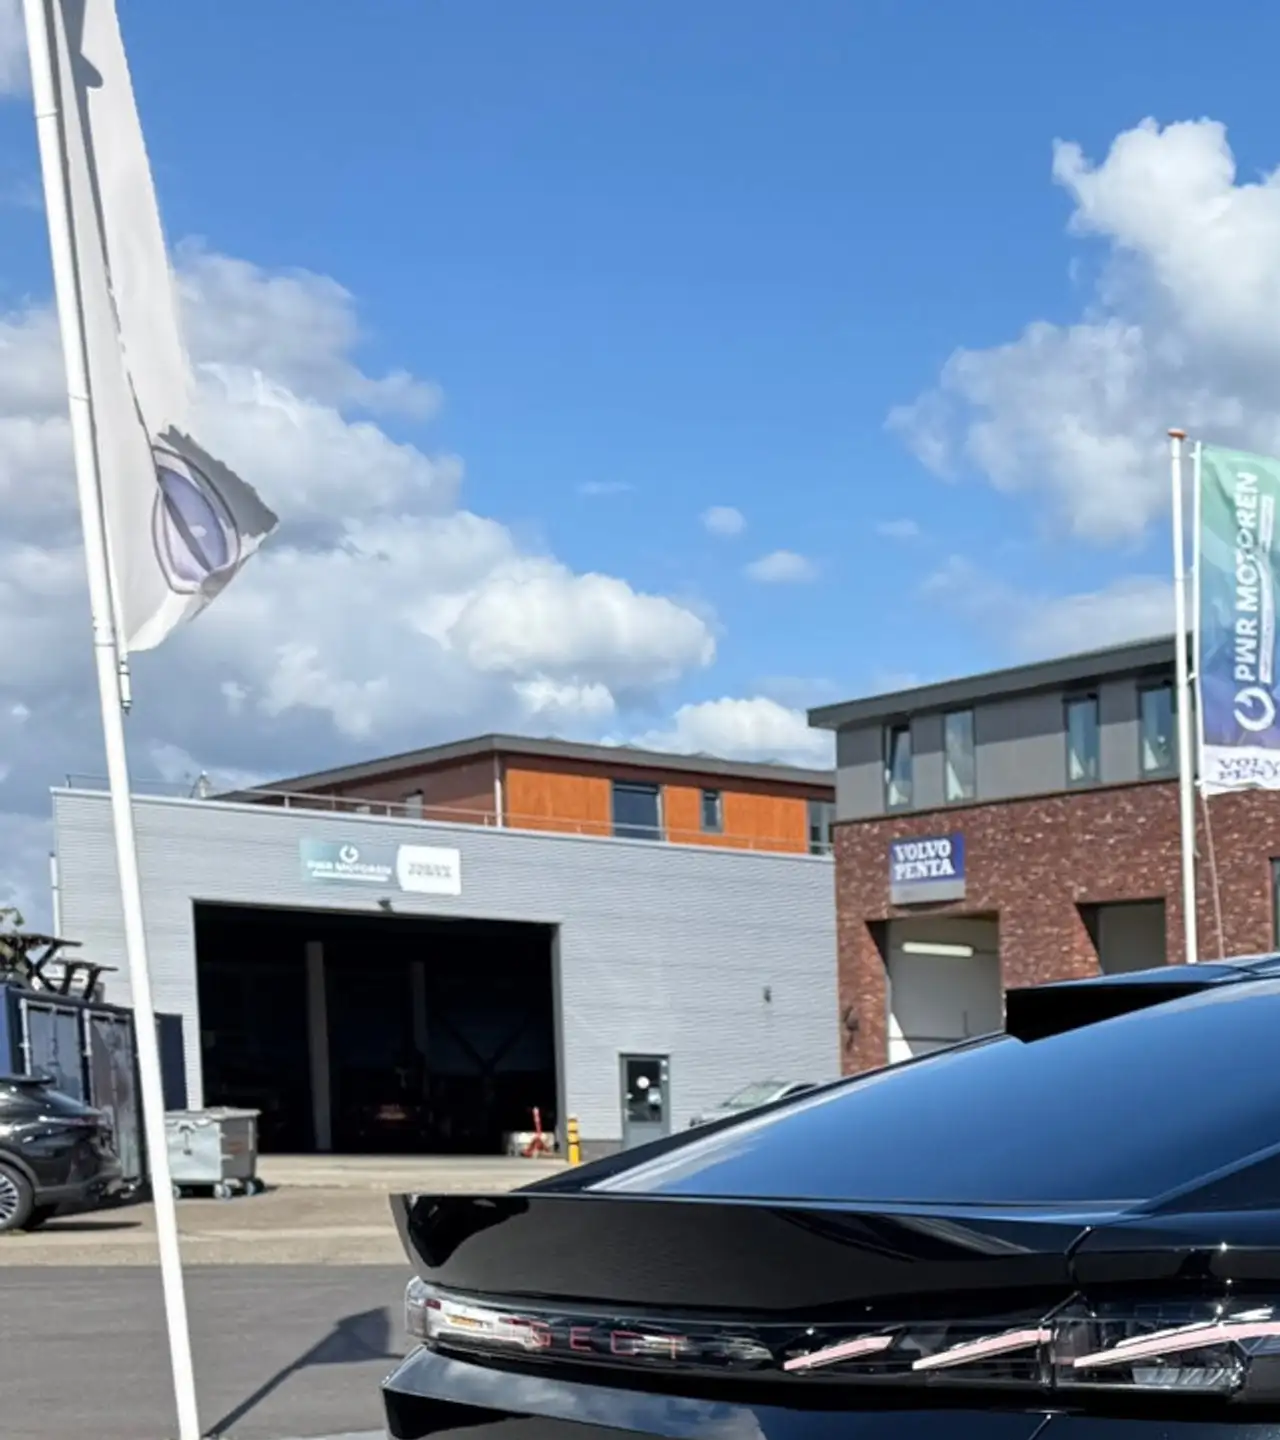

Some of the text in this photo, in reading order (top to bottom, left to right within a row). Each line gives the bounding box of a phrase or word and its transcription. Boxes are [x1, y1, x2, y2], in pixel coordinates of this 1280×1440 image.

[1235, 472, 1258, 682] PWR MOTOREN
[893, 838, 952, 862] VOLVO
[894, 858, 956, 881] PENTA
